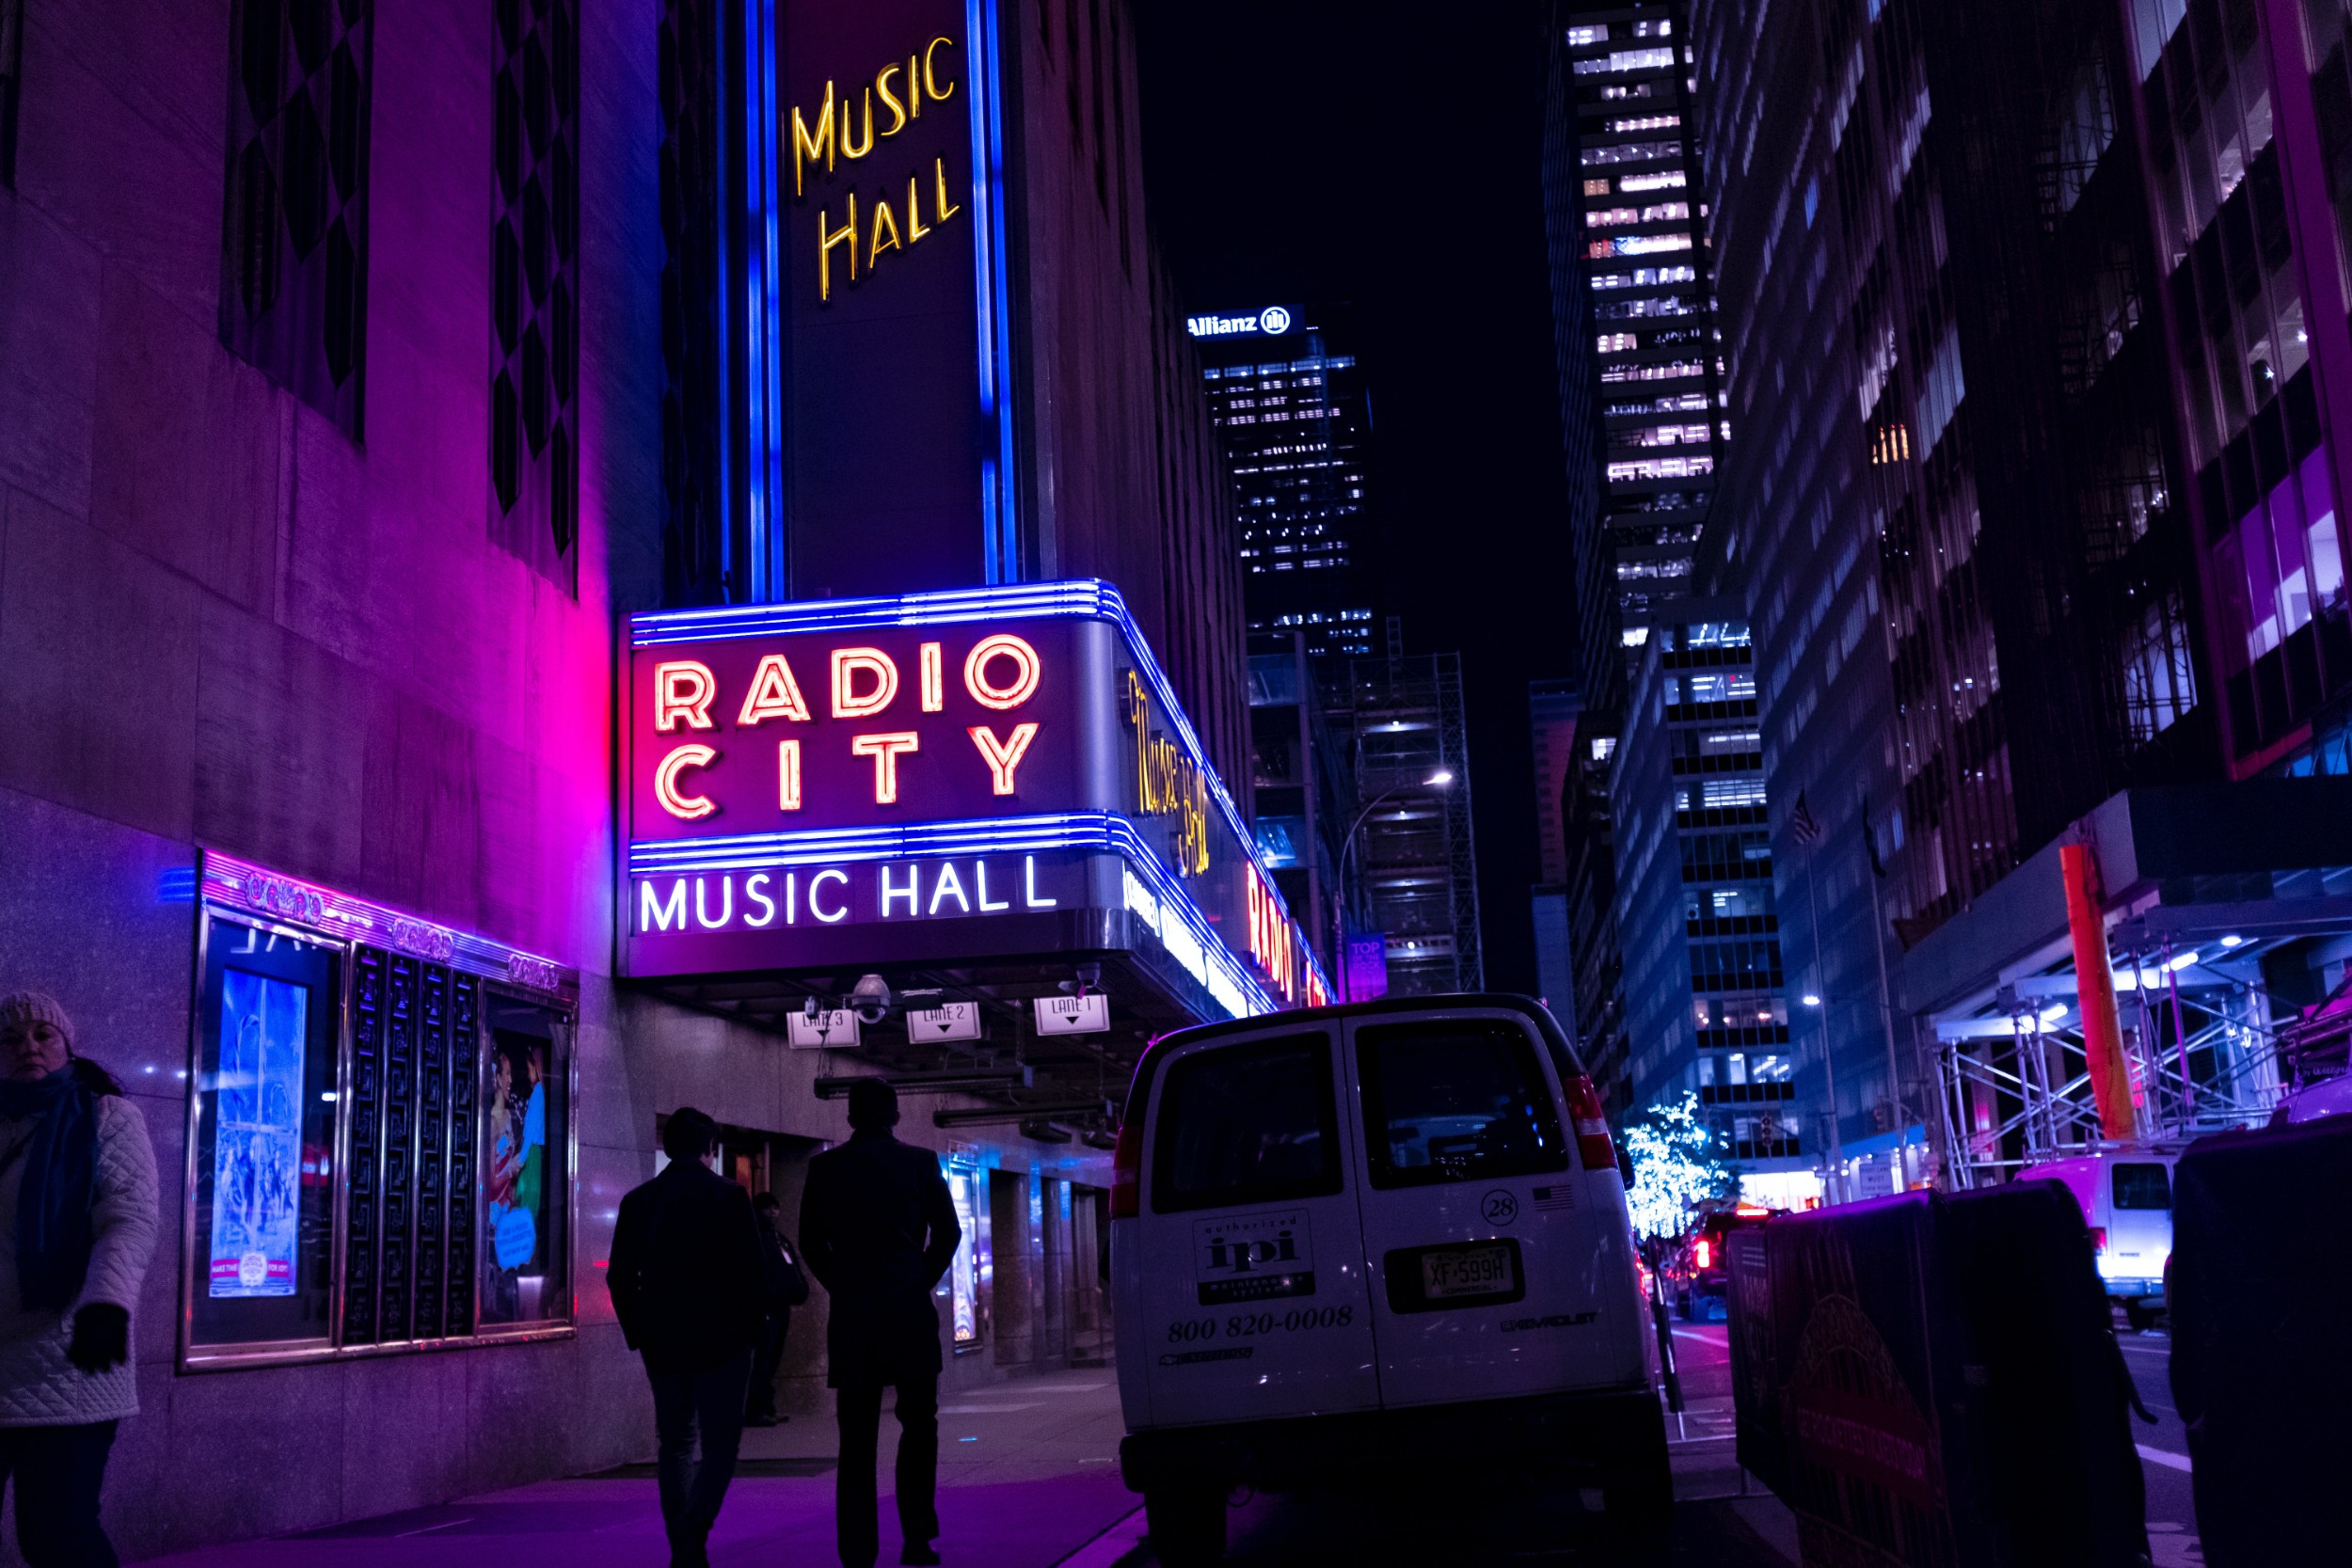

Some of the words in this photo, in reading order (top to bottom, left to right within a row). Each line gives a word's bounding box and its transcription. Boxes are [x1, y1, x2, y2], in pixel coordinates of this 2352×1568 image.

[792, 37, 953, 196] MUSIC
[818, 157, 960, 300] HALL
[1187, 316, 1258, 336] Allianz
[655, 634, 1041, 731] RADIO
[655, 722, 1041, 819] CITY
[641, 868, 848, 932] MUSIC
[882, 855, 1057, 917] HALL
[1247, 860, 1293, 1002] RADIO
[1351, 942, 1380, 954] TOP
[1354, 961, 1380, 970] ROCK
[956, 1006, 965, 1021] 2
[1052, 997, 1083, 1013] LANE
[1086, 997, 1091, 1011] 1
[834, 1011, 844, 1026] 3
[1487, 1197, 1513, 1217] 28
[1205, 1216, 1297, 1234] authorized
[1204, 1230, 1301, 1273] ipi
[1445, 1285, 1491, 1295] COMMERCIAL
[1168, 1319, 1216, 1343] 800
[1226, 1306, 1352, 1338] 820-0008
[1500, 1312, 1597, 1332] CHEVROLET
